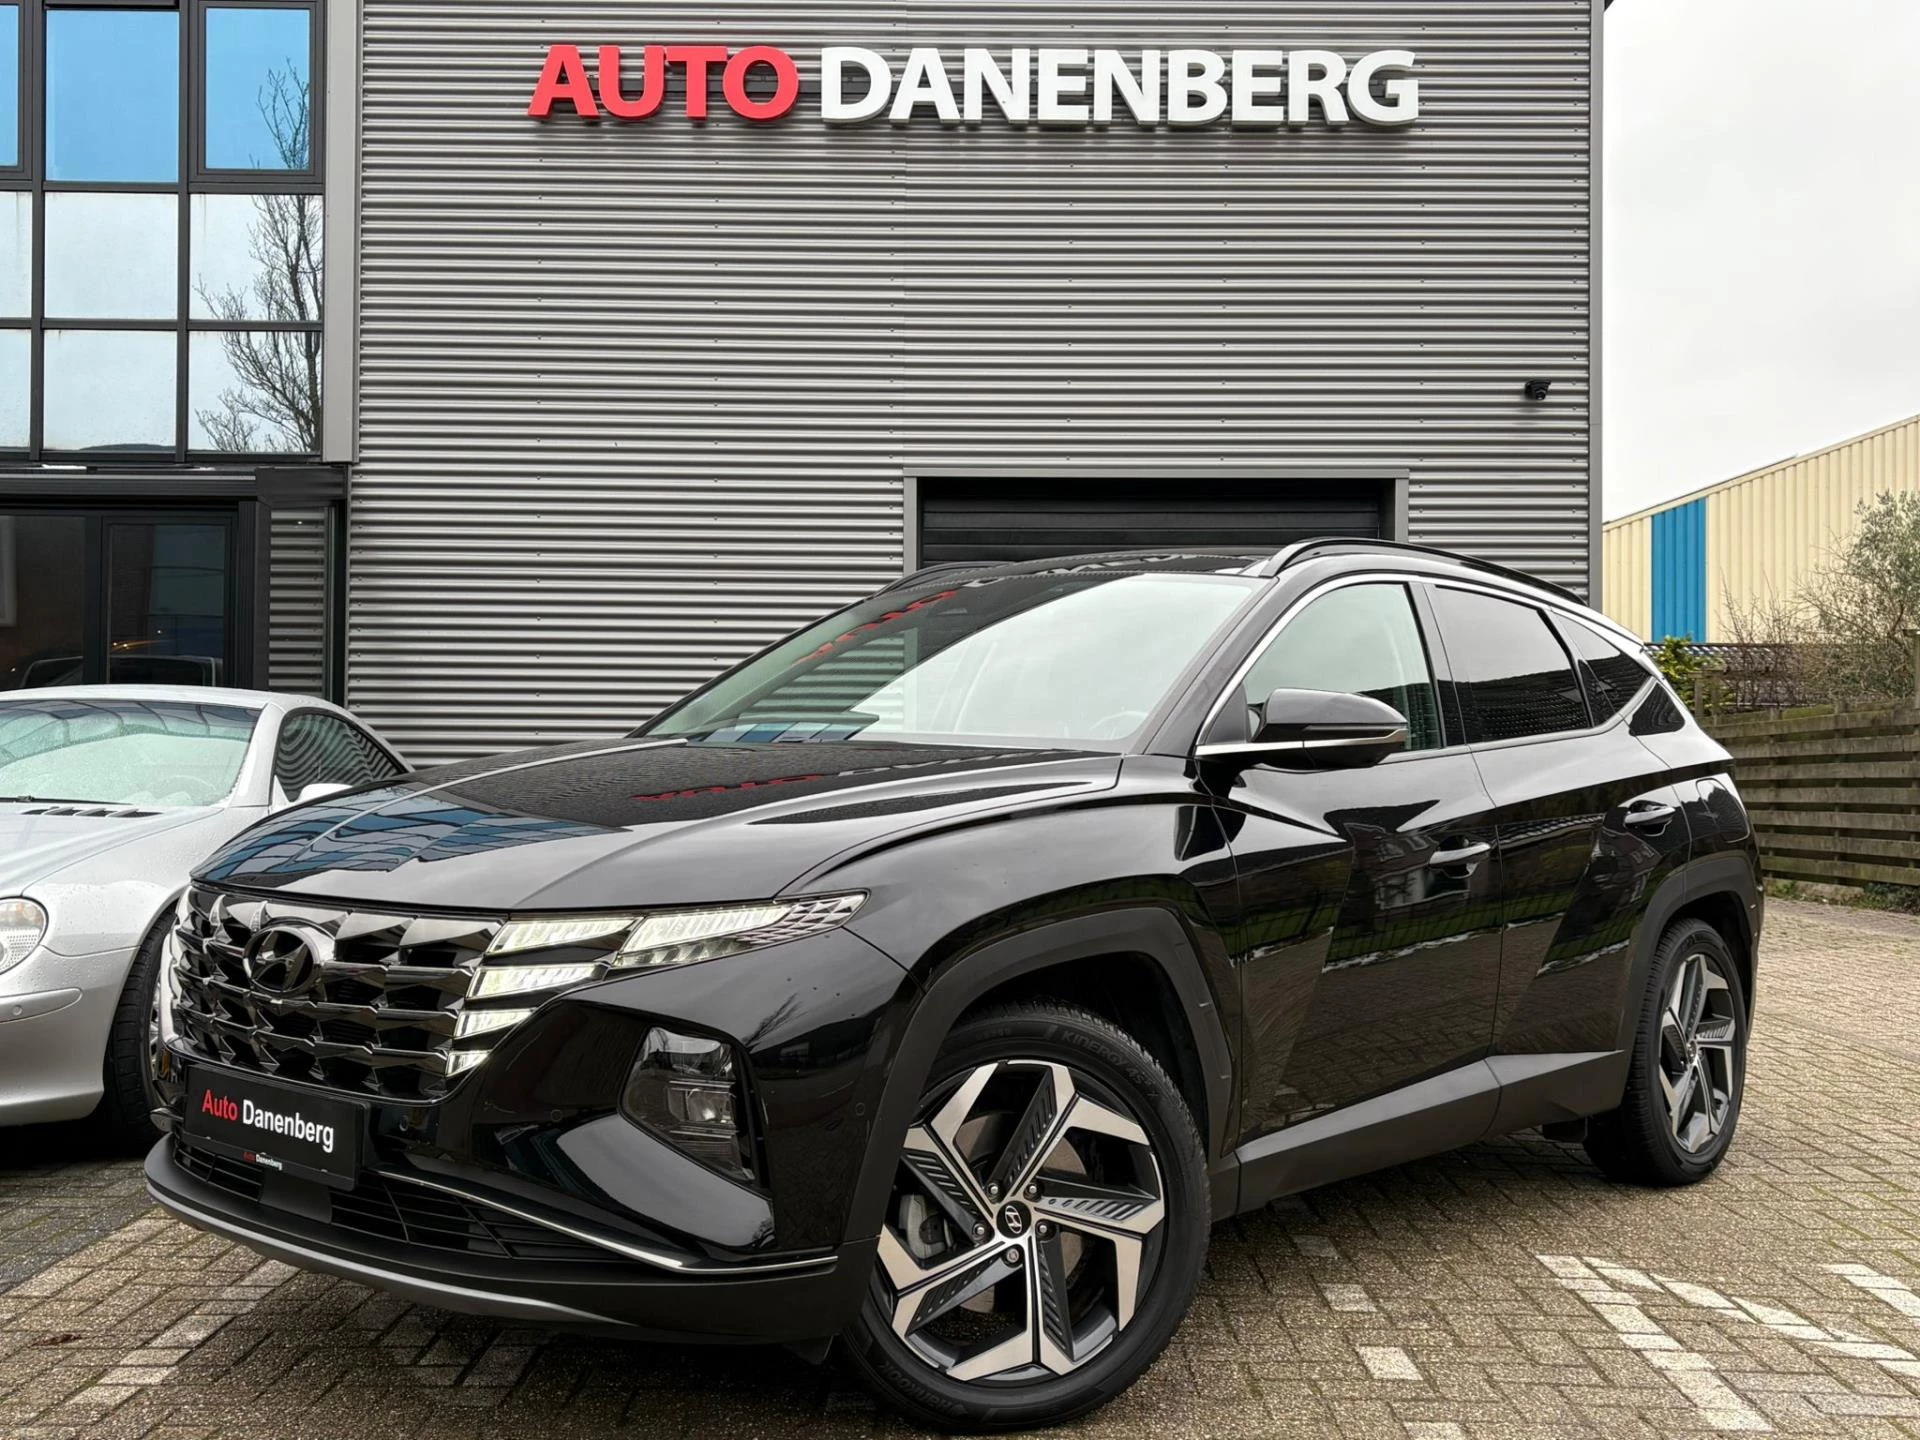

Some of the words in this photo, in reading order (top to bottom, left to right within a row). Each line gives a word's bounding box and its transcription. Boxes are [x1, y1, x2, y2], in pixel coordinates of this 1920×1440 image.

[527, 44, 799, 122] AUTO
[821, 46, 1419, 127] DANENBERG
[202, 1089, 238, 1121] Auto
[243, 1099, 334, 1153] Danenberg
